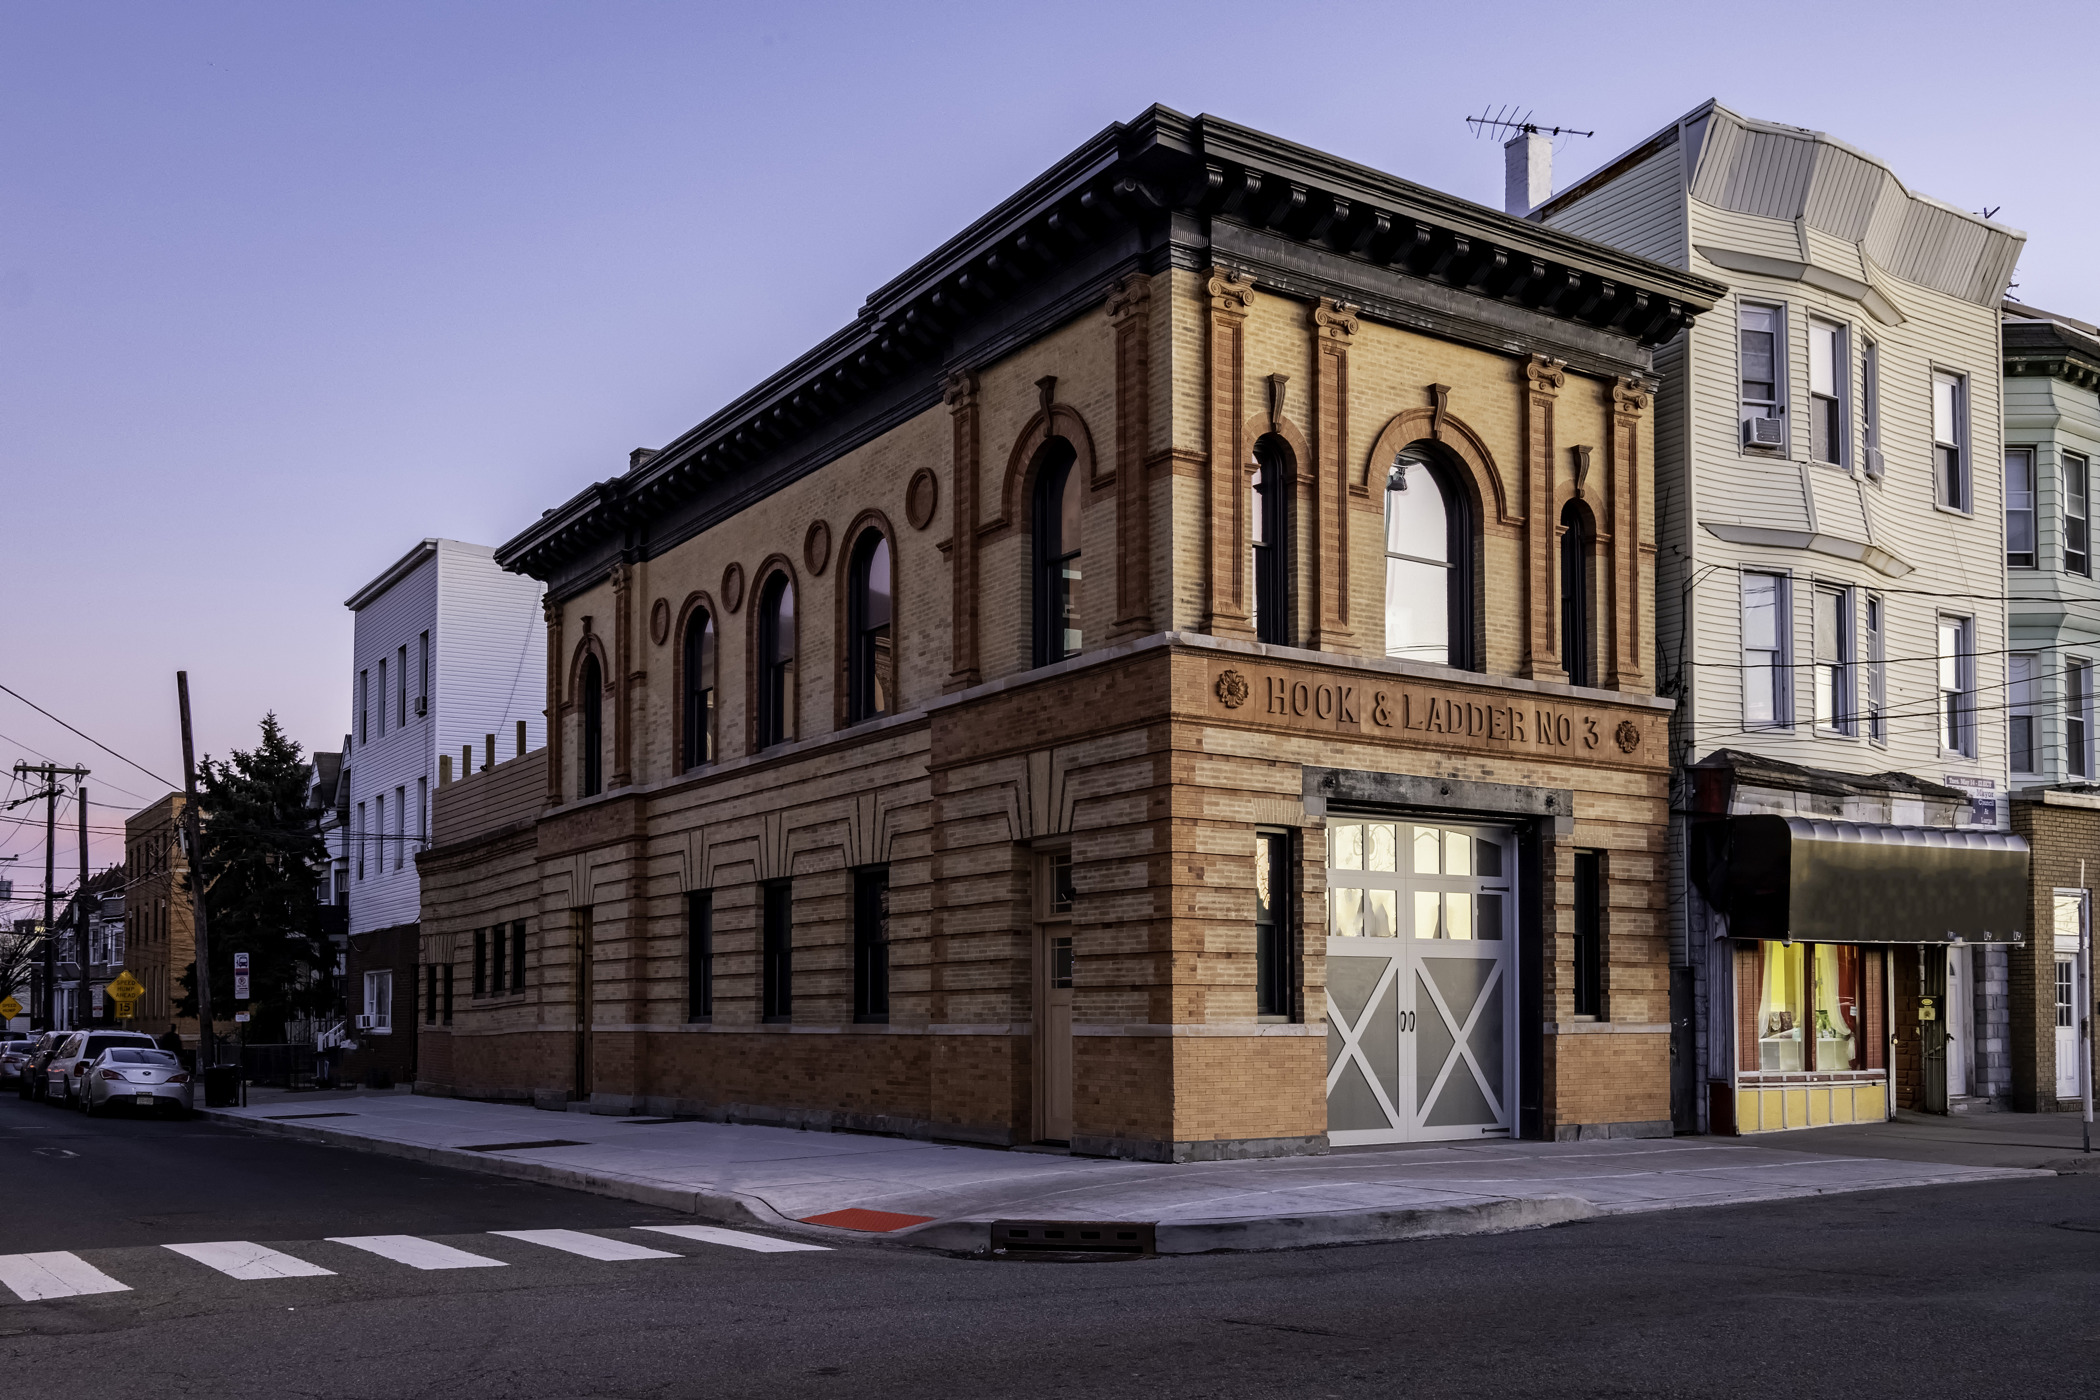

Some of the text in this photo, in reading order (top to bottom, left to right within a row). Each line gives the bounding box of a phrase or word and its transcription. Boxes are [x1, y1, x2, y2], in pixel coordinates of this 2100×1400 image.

[1266, 676, 1600, 750] HOOK & LADDER NO 3
[1978, 780, 1992, 788] ELECT
[1976, 789, 1994, 798] Mayor
[1980, 817, 1993, 825] Large
[119, 1003, 131, 1012] 15
